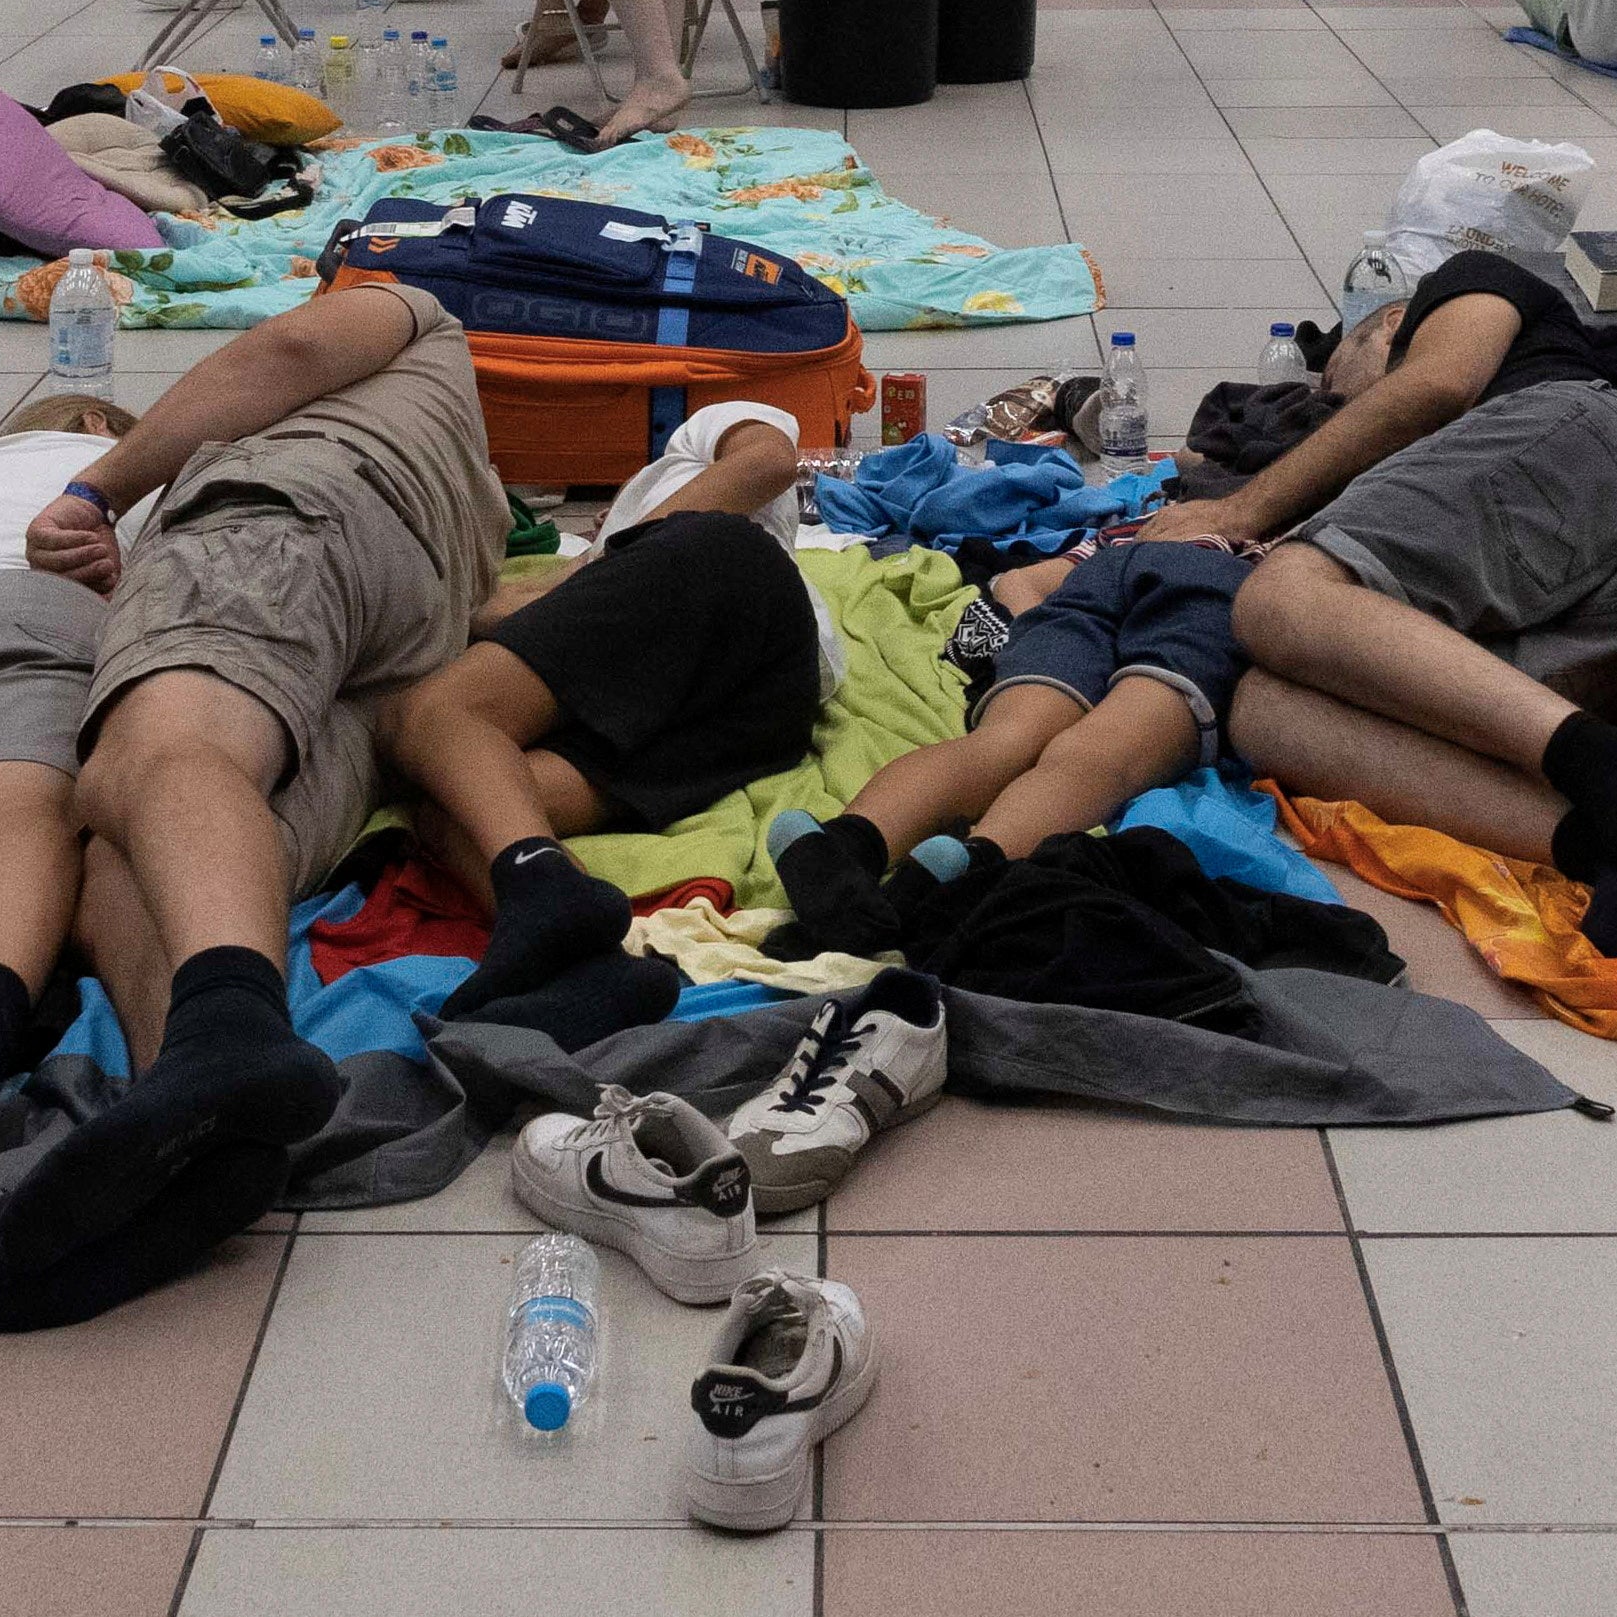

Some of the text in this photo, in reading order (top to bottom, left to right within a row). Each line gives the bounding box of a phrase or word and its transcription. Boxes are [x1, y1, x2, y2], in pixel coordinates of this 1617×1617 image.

[1500, 161, 1571, 192] WELCOME
[471, 291, 649, 338] OGIO
[710, 1402, 745, 1418] AIR
